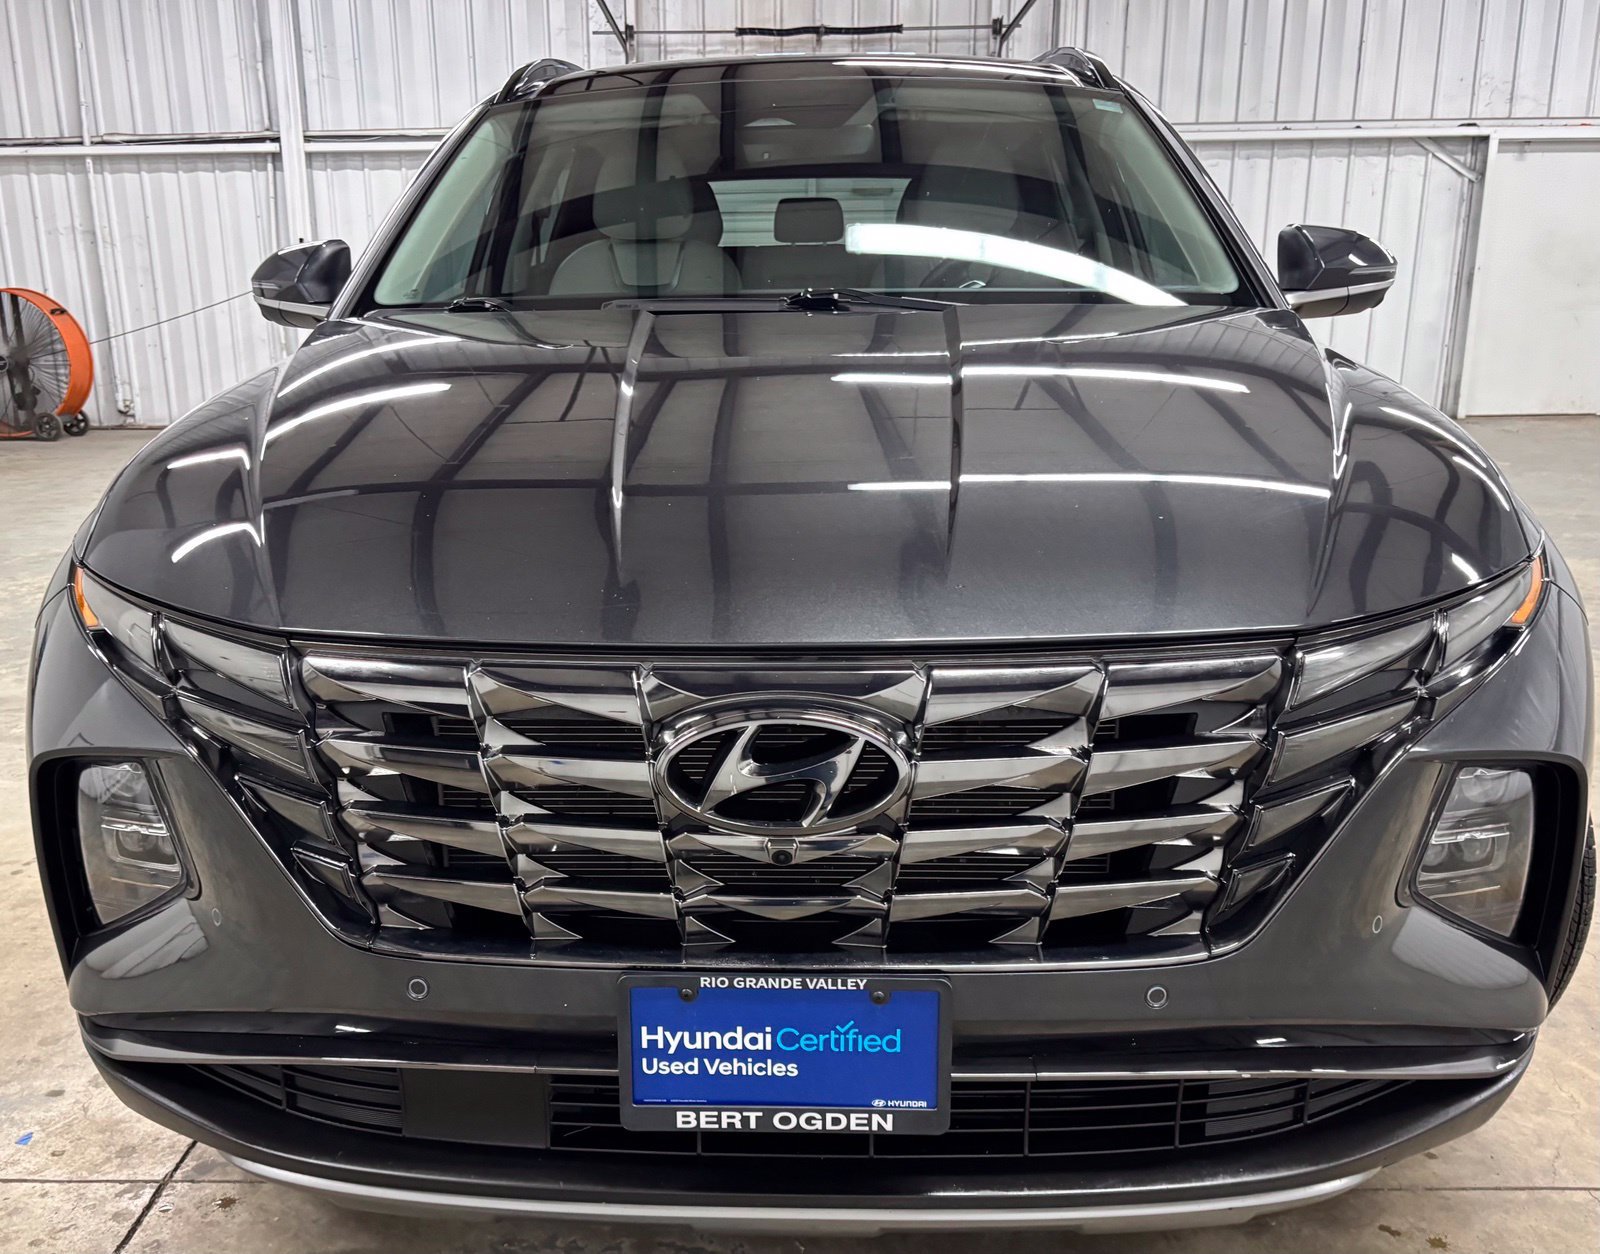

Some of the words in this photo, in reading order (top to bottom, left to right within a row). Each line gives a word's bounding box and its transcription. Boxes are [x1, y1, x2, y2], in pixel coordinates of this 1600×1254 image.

[700, 977, 729, 988] RIO
[733, 978, 802, 989] GRANDE
[806, 978, 868, 990] VALLEY
[641, 1026, 772, 1054] Hyundai
[776, 1020, 901, 1053] Certified
[642, 1058, 699, 1075] Used
[703, 1058, 799, 1076] Vehicles
[887, 1100, 927, 1108] HYUNDAI
[676, 1111, 763, 1129] BERT
[772, 1113, 894, 1132] OGDEN
